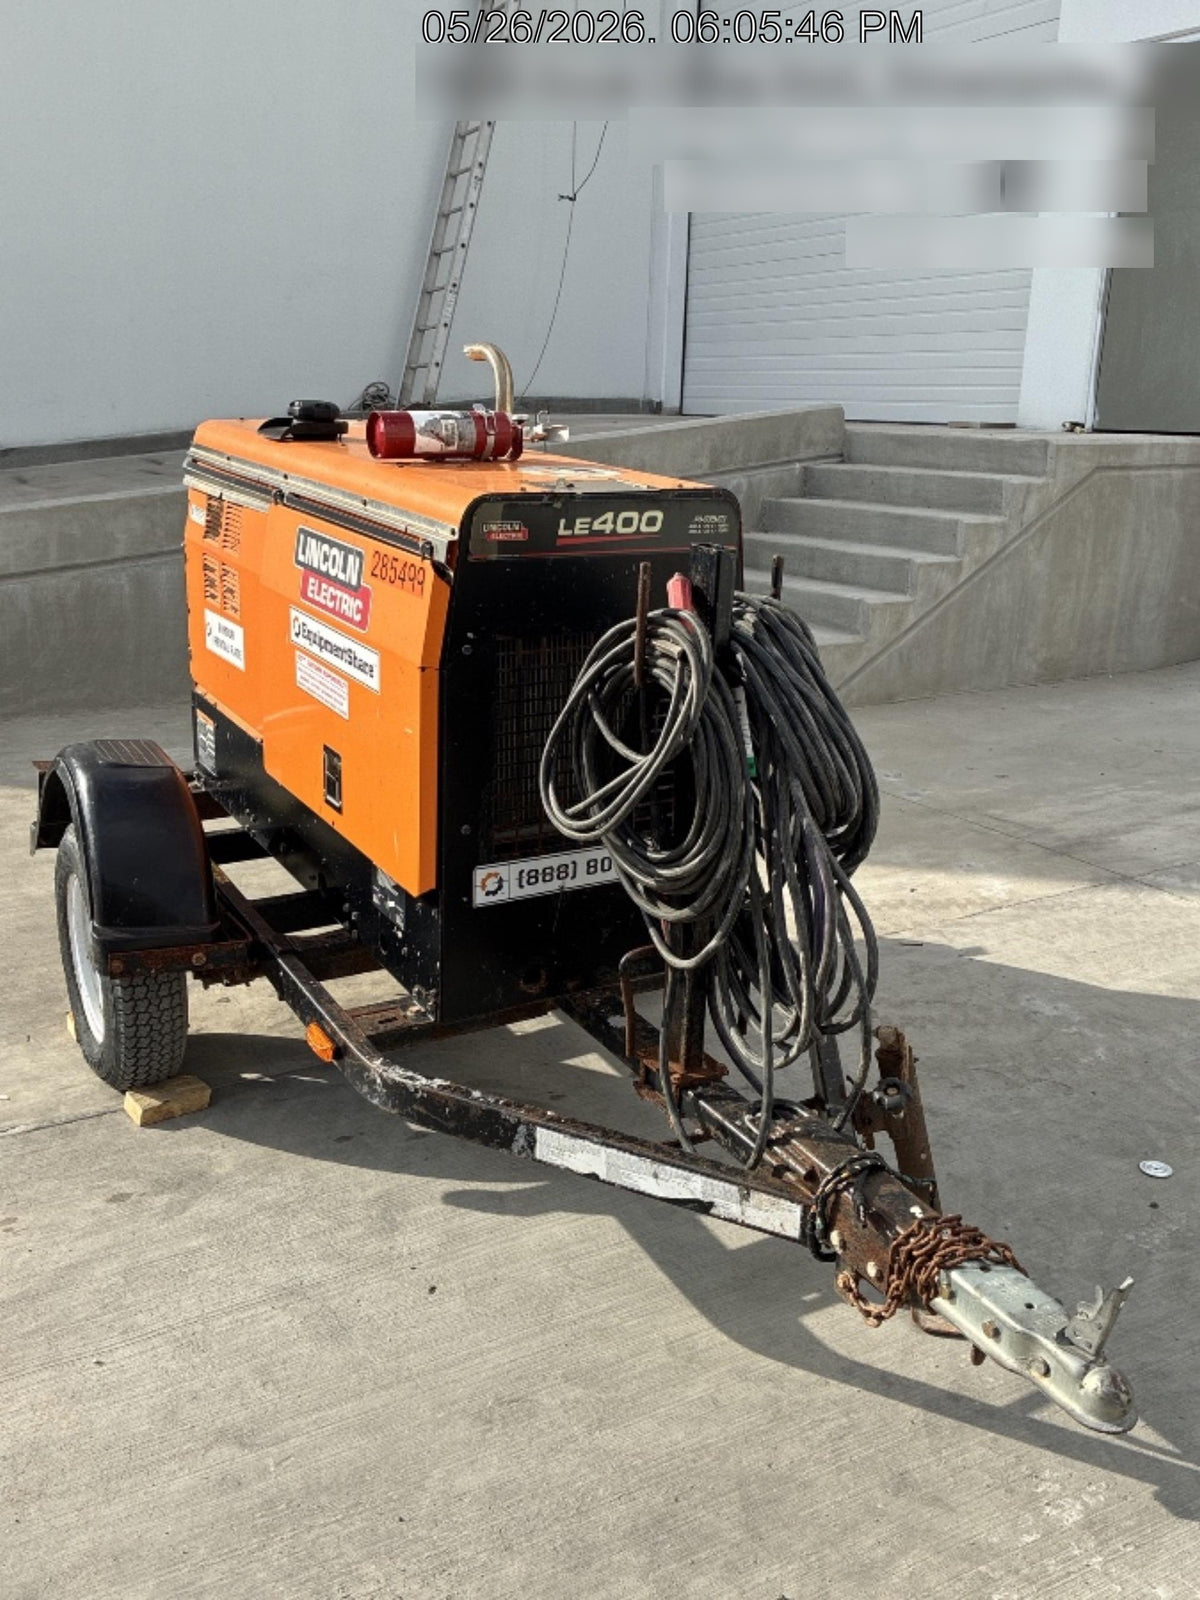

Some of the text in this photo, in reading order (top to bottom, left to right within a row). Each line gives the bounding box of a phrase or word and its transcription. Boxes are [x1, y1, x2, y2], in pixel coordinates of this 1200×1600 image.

[482, 522, 521, 532] LINCOLN
[558, 509, 664, 536] LE400
[297, 533, 361, 587] LINCOLN
[370, 550, 426, 600] 285499
[306, 576, 364, 622] ELECTRIC
[518, 860, 577, 889] (888)
